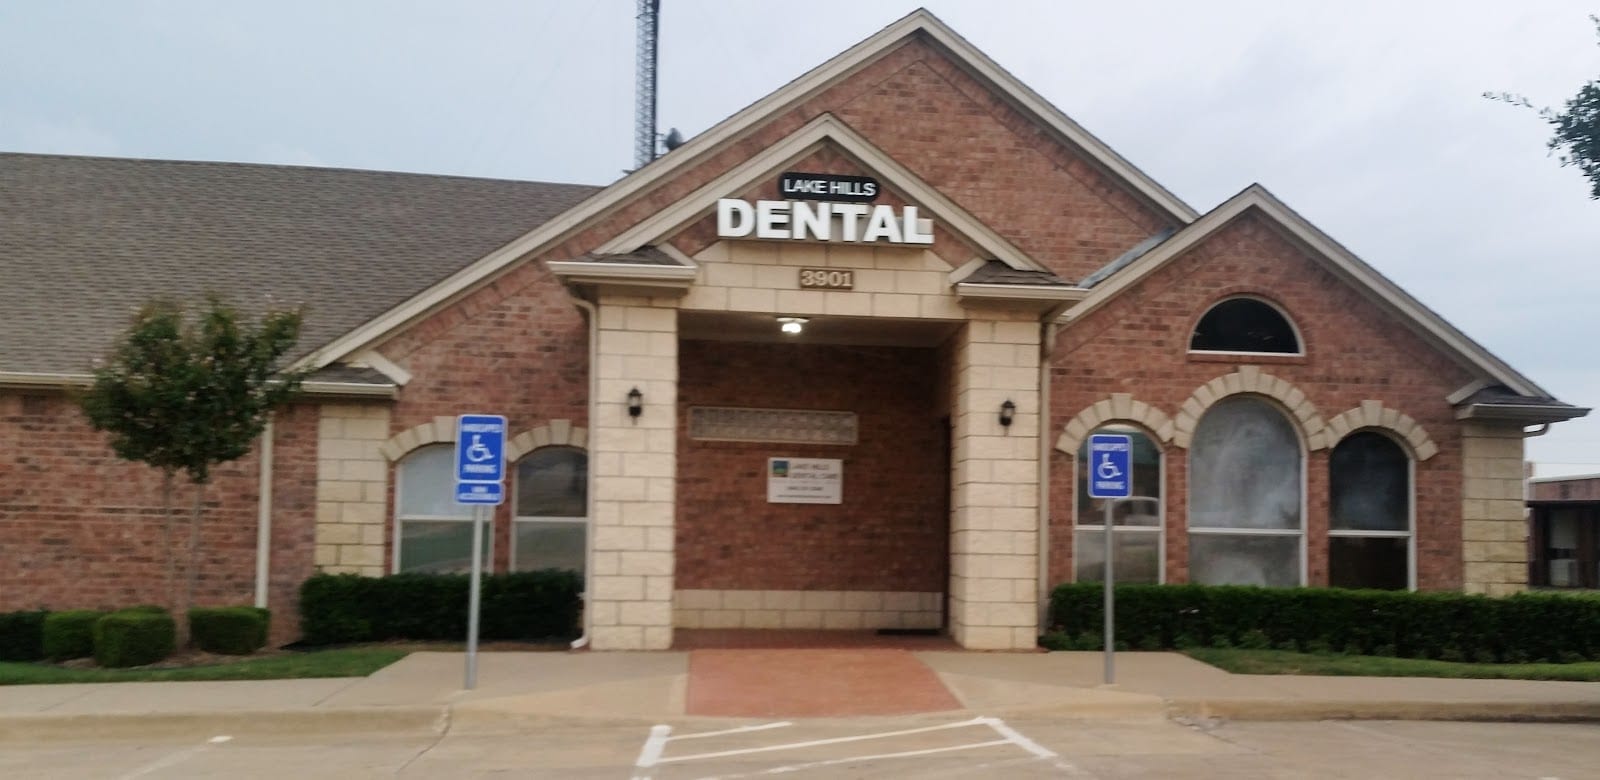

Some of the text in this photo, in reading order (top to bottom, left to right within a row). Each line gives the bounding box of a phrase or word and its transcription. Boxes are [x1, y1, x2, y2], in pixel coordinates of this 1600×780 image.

[784, 178, 876, 196] LAKE HILLS
[717, 198, 934, 244] DENTAL
[801, 270, 852, 287] 3901
